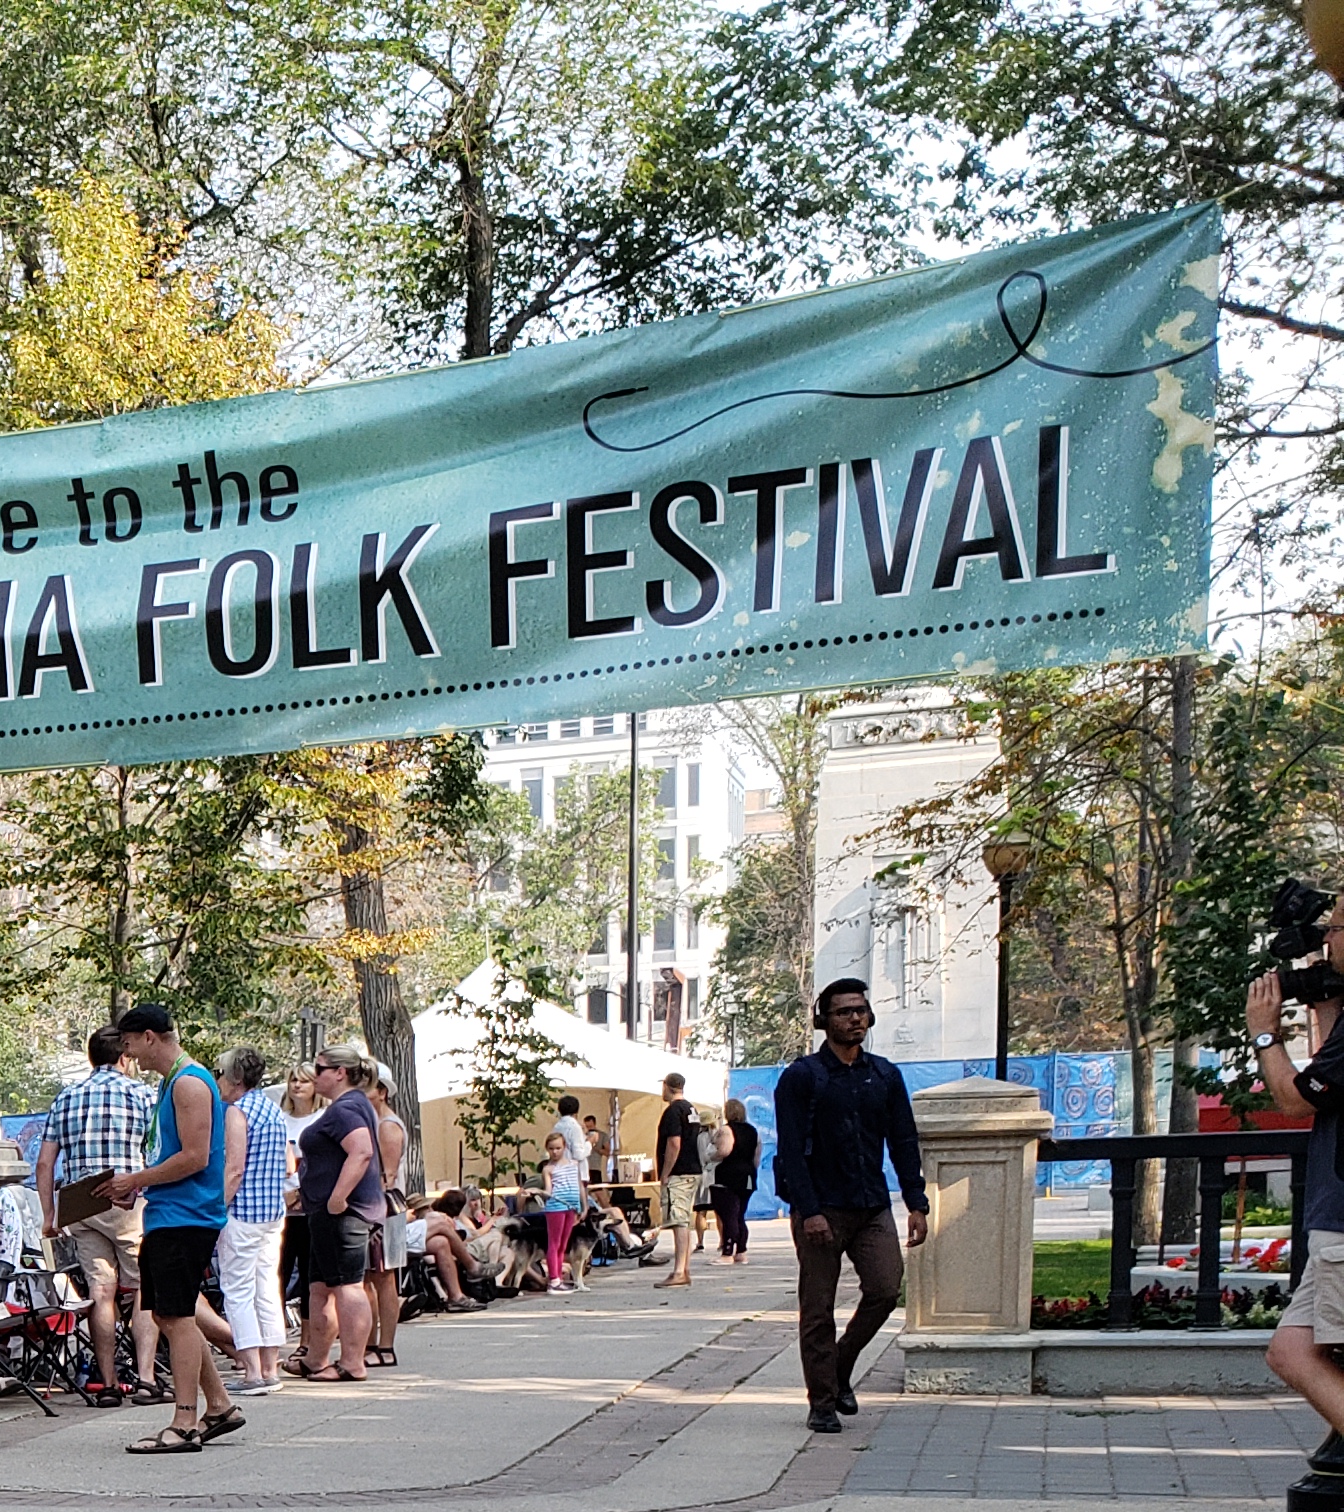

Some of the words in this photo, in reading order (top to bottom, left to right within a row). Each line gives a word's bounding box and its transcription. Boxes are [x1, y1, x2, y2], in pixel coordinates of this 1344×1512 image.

[67, 477, 142, 547] to
[172, 450, 299, 534] the
[136, 522, 443, 687] FOLK
[489, 424, 1116, 649] FESTIVAL
